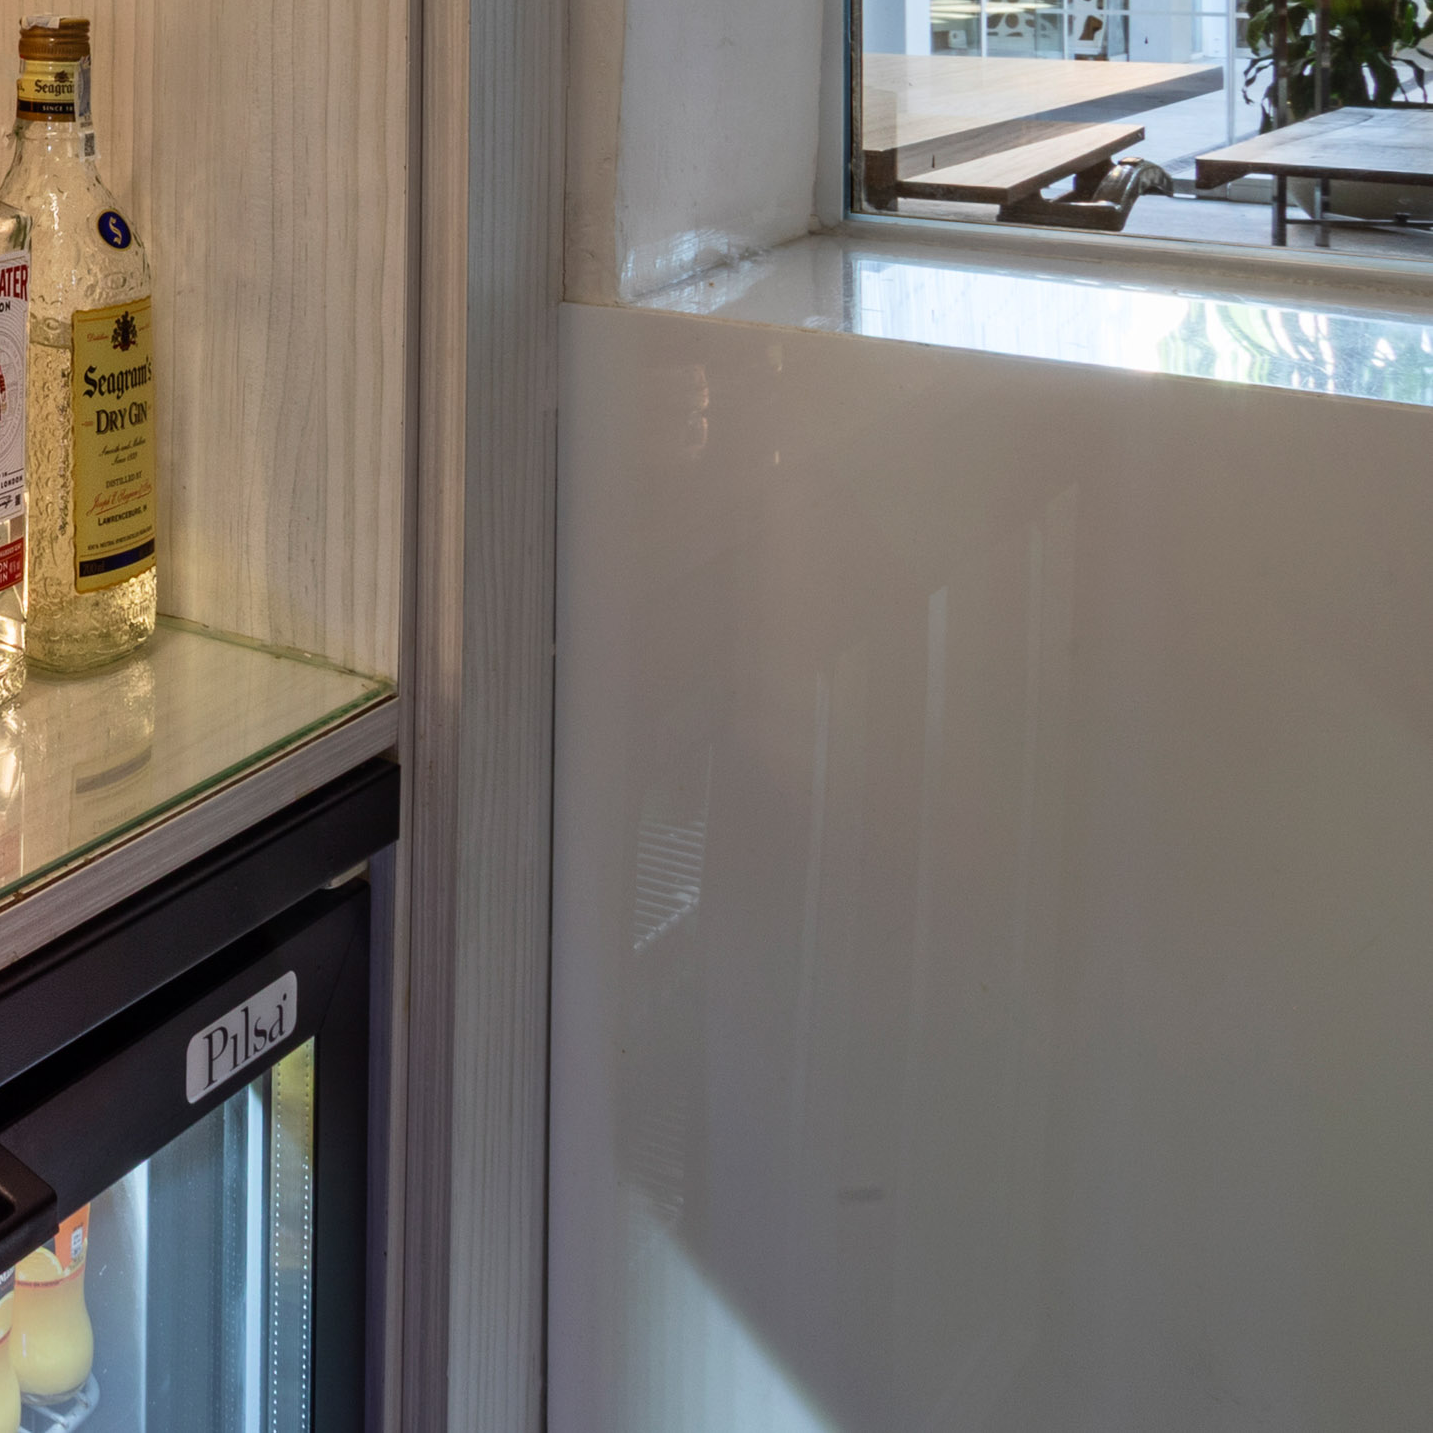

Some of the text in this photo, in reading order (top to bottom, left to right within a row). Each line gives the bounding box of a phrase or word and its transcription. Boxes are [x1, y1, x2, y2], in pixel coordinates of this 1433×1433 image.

[83, 355, 152, 399] Seagram's
[95, 400, 148, 435] DRY GIN
[0, 475, 23, 489] LONDON
[105, 473, 135, 489] DISTILLED
